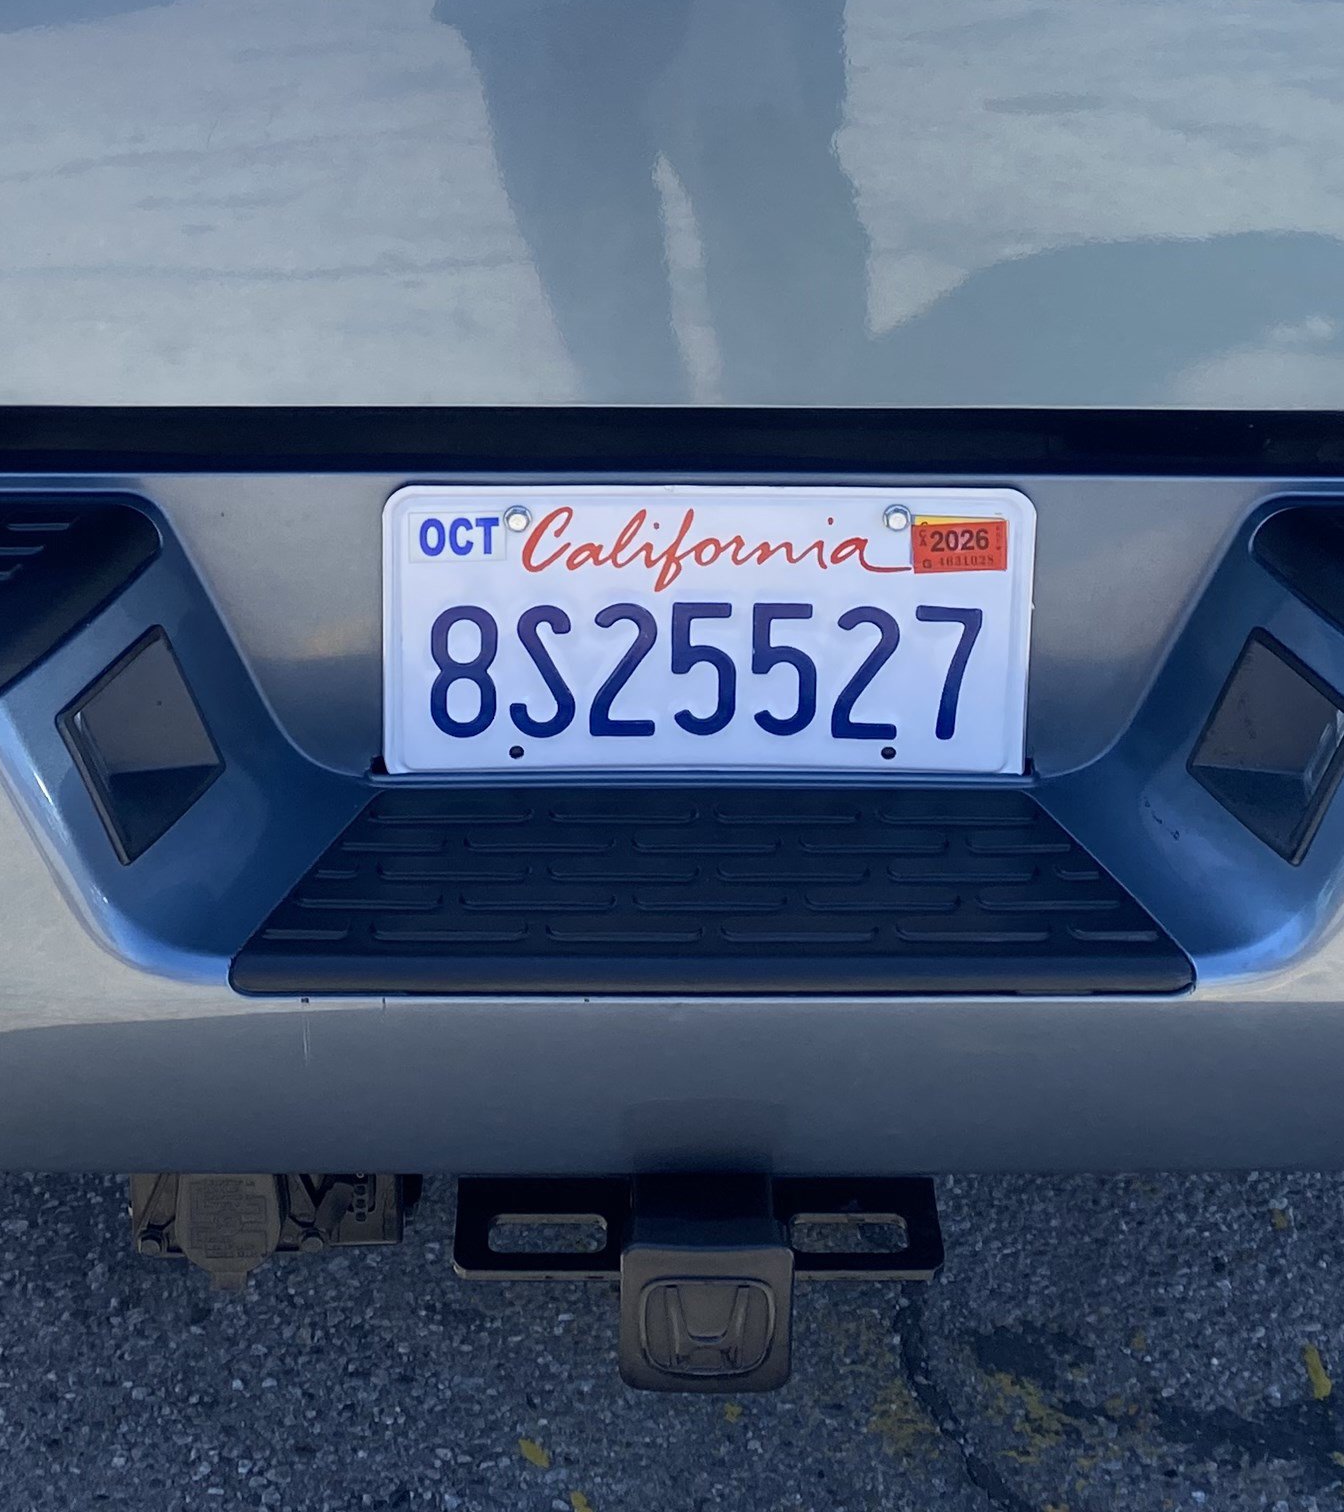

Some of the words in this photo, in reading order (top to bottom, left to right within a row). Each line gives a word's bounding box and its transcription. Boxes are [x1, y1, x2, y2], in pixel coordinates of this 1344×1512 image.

[418, 516, 500, 556] OCT
[521, 506, 911, 592] California
[930, 528, 990, 553] 2026
[430, 602, 983, 739] 8S25527
